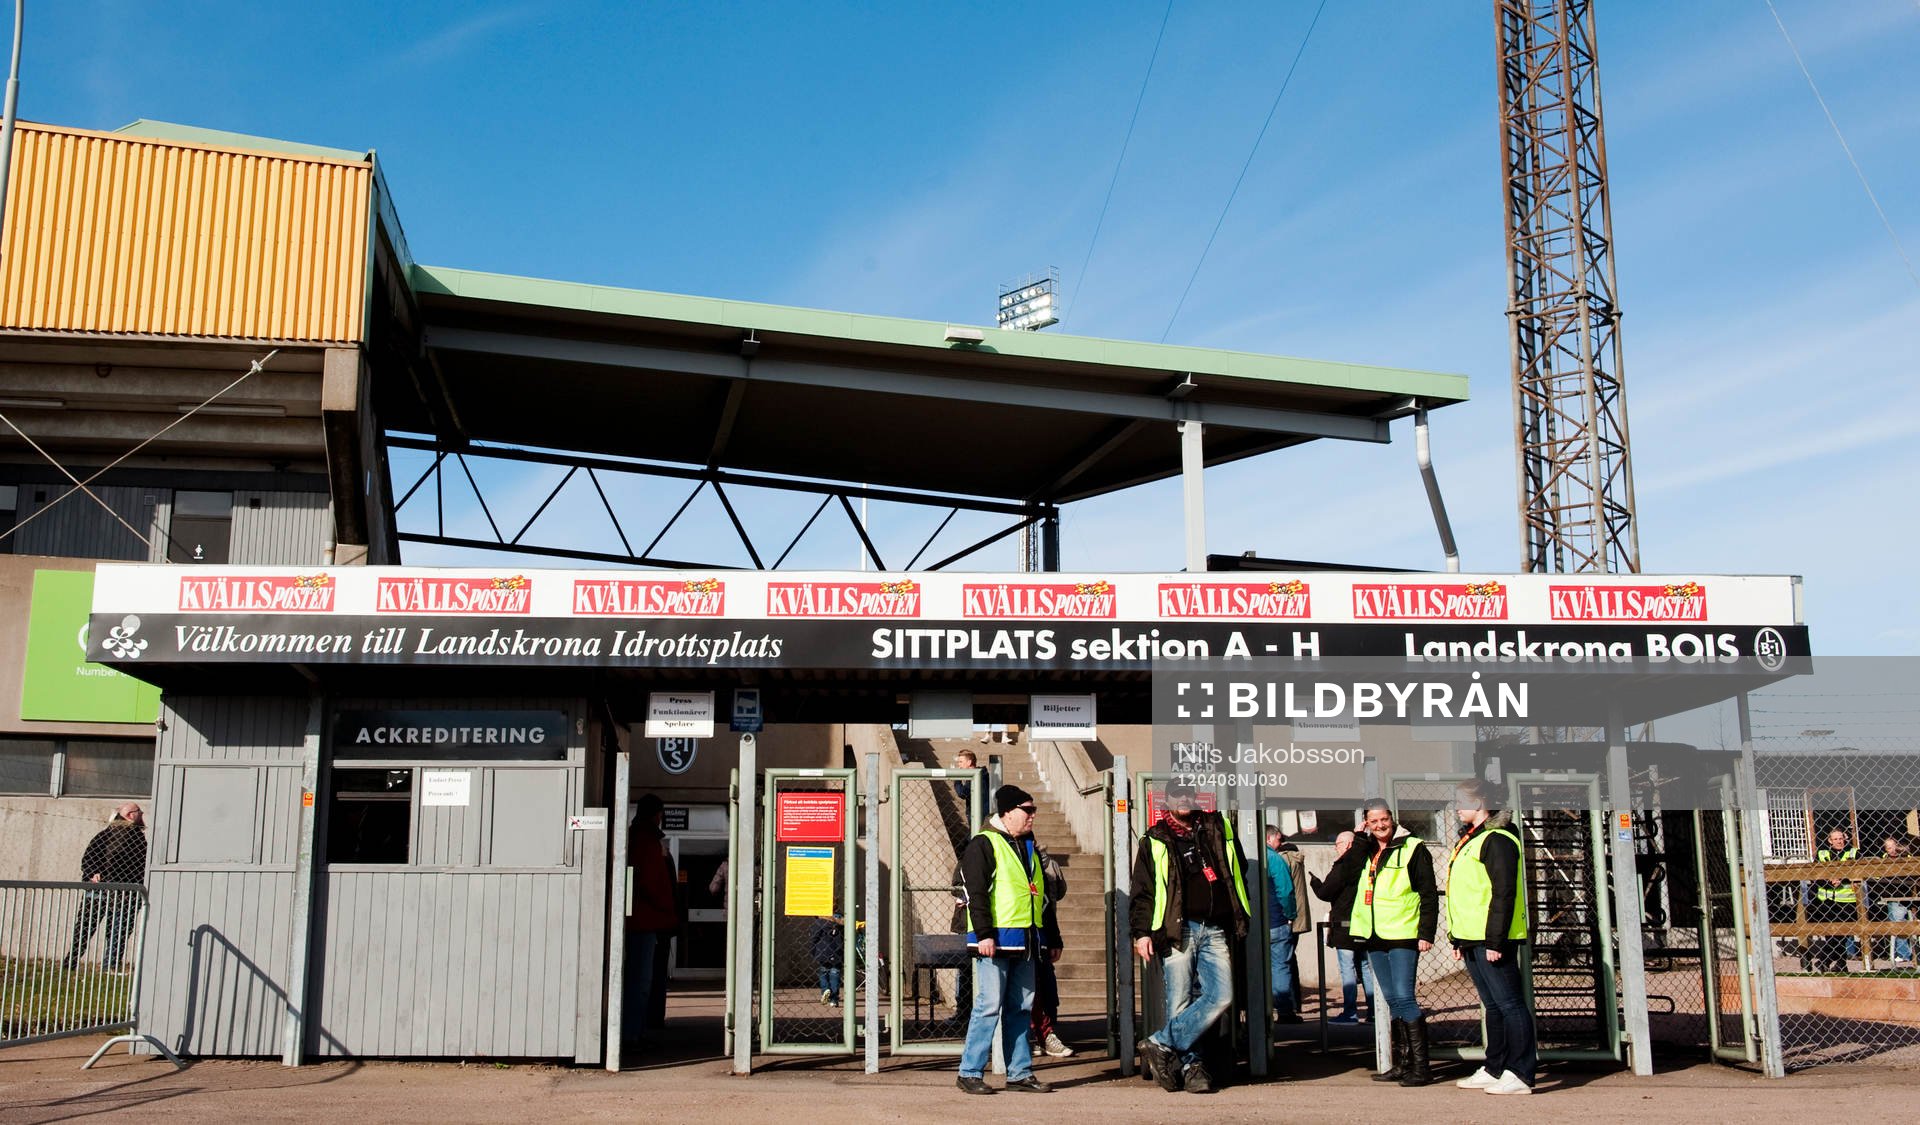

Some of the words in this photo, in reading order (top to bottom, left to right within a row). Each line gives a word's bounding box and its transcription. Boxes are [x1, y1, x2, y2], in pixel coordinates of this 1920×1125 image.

[175, 625, 352, 653] Välkommen
[361, 627, 407, 654] till
[414, 628, 601, 656] Landskrona
[609, 630, 784, 665] Idrottsplats
[872, 627, 1057, 660] SITTPLATS
[1070, 627, 1209, 661] sektion
[1223, 631, 1252, 661] A
[1292, 631, 1320, 661] H
[1405, 630, 1632, 663] Landskrona
[1646, 632, 1740, 664] BOIS
[76, 667, 117, 677] Number
[1043, 704, 1081, 713] Biljetter
[1034, 720, 1091, 728] Abonnemang
[355, 726, 546, 744] ACKREDITERING
